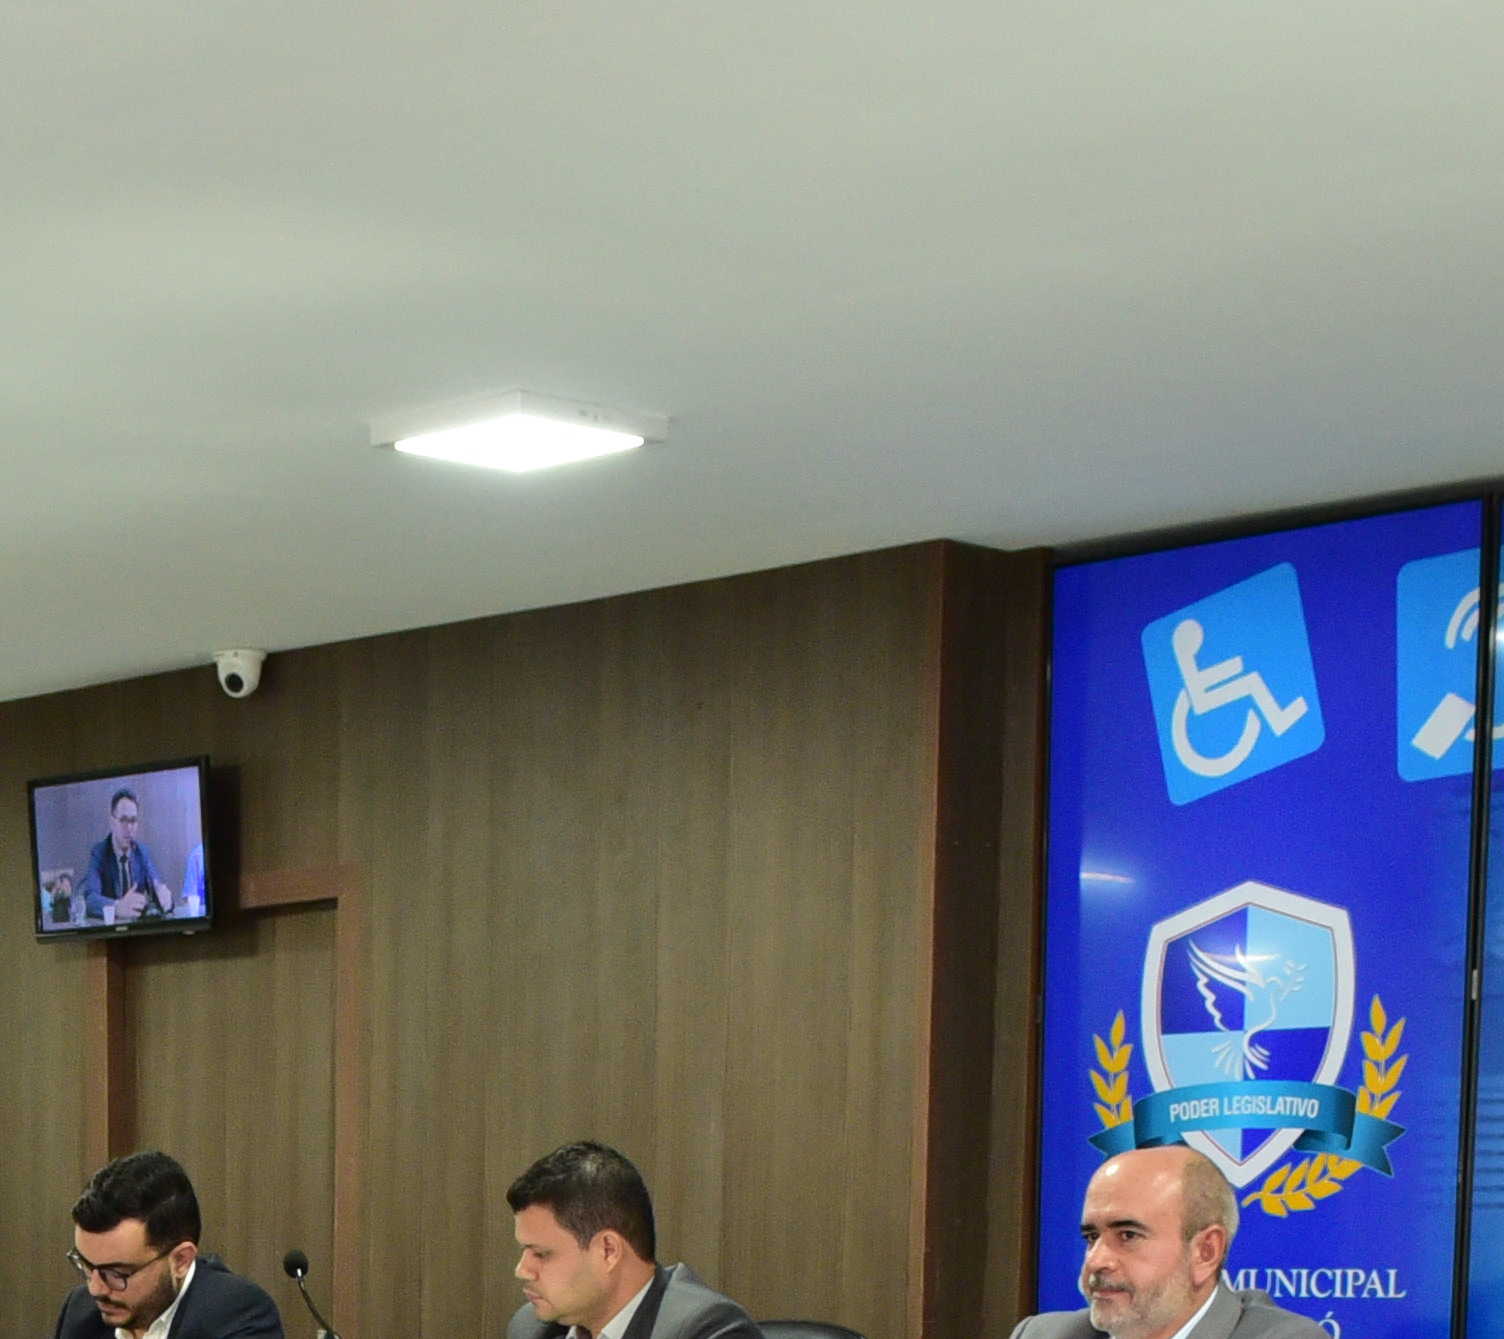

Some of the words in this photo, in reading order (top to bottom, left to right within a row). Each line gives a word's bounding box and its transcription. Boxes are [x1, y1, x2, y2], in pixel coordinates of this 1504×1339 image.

[1169, 1096, 1221, 1123] PODER
[1222, 1094, 1320, 1119] LEGISLATIVO
[1219, 1267, 1407, 1299] MUNICIPAL
